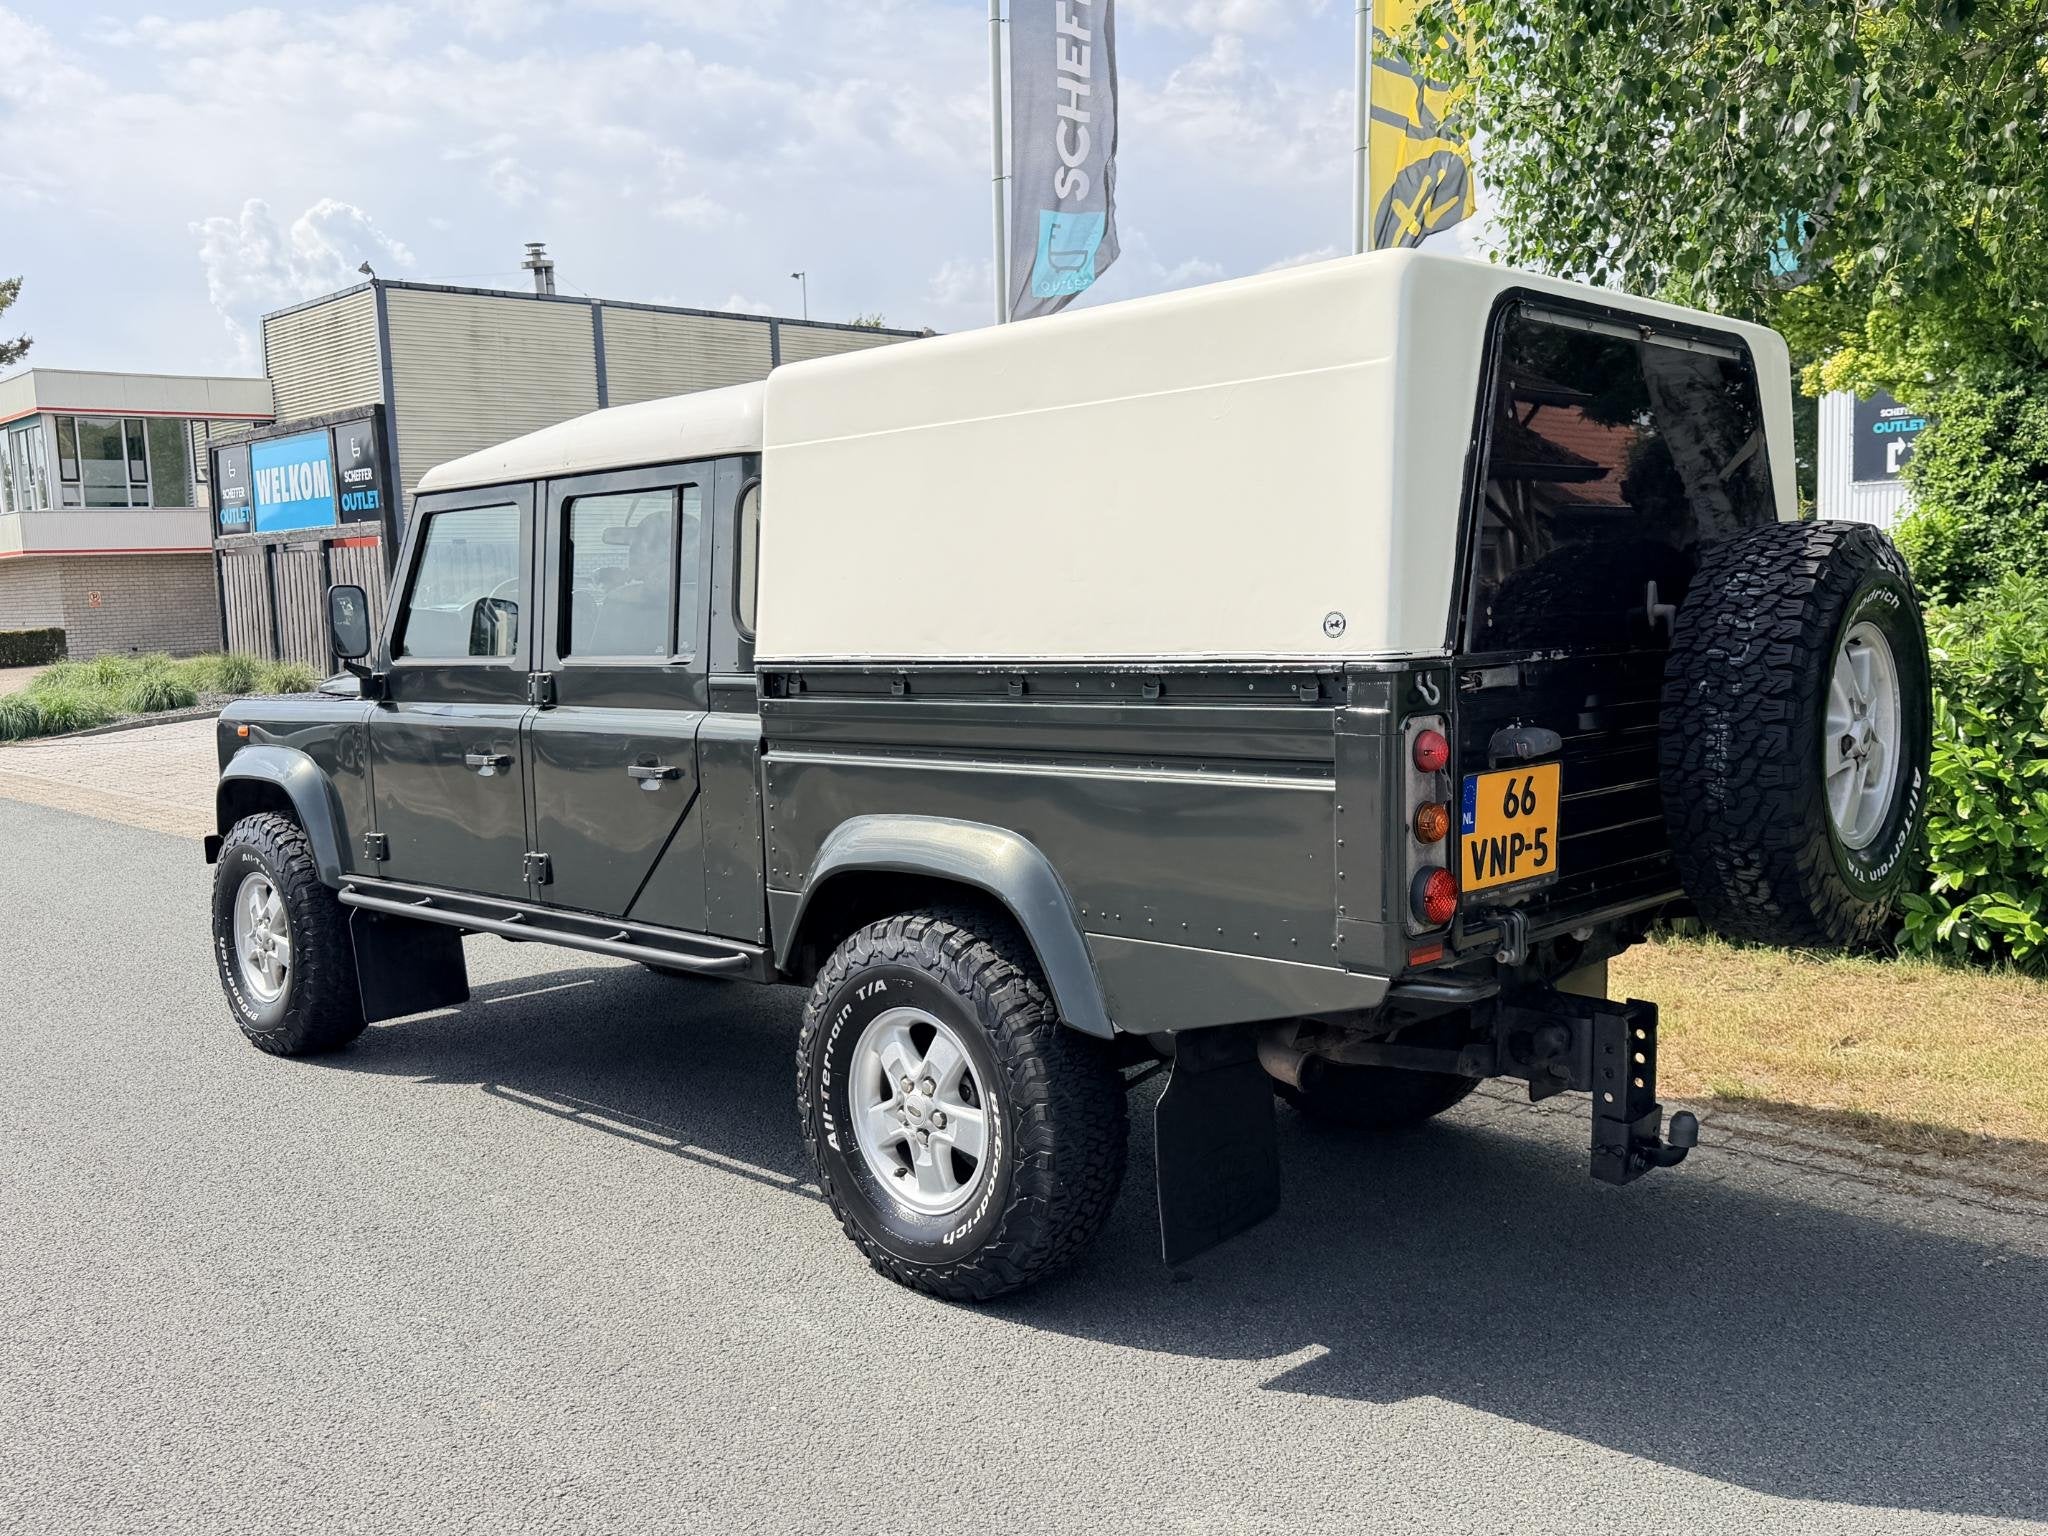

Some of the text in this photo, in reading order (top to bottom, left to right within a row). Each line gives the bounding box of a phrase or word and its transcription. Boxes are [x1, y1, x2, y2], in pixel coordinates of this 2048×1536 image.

[1054, 0, 1092, 201] SCHEF
[1872, 418, 1926, 434] OUTLET
[222, 487, 246, 500] SCHEFFER
[255, 459, 331, 506] WELKOM
[344, 467, 373, 483] SCHEFFER
[220, 506, 250, 525] OUTLET
[341, 489, 380, 512] OUTLET
[1462, 812, 1474, 825] NL
[1503, 775, 1536, 819] 66
[1869, 766, 1922, 882] All-Terrain
[1471, 827, 1548, 880] VNP-5
[820, 979, 888, 1152] All-Terrain T/A
[943, 1090, 1002, 1246] BFGoodrich
